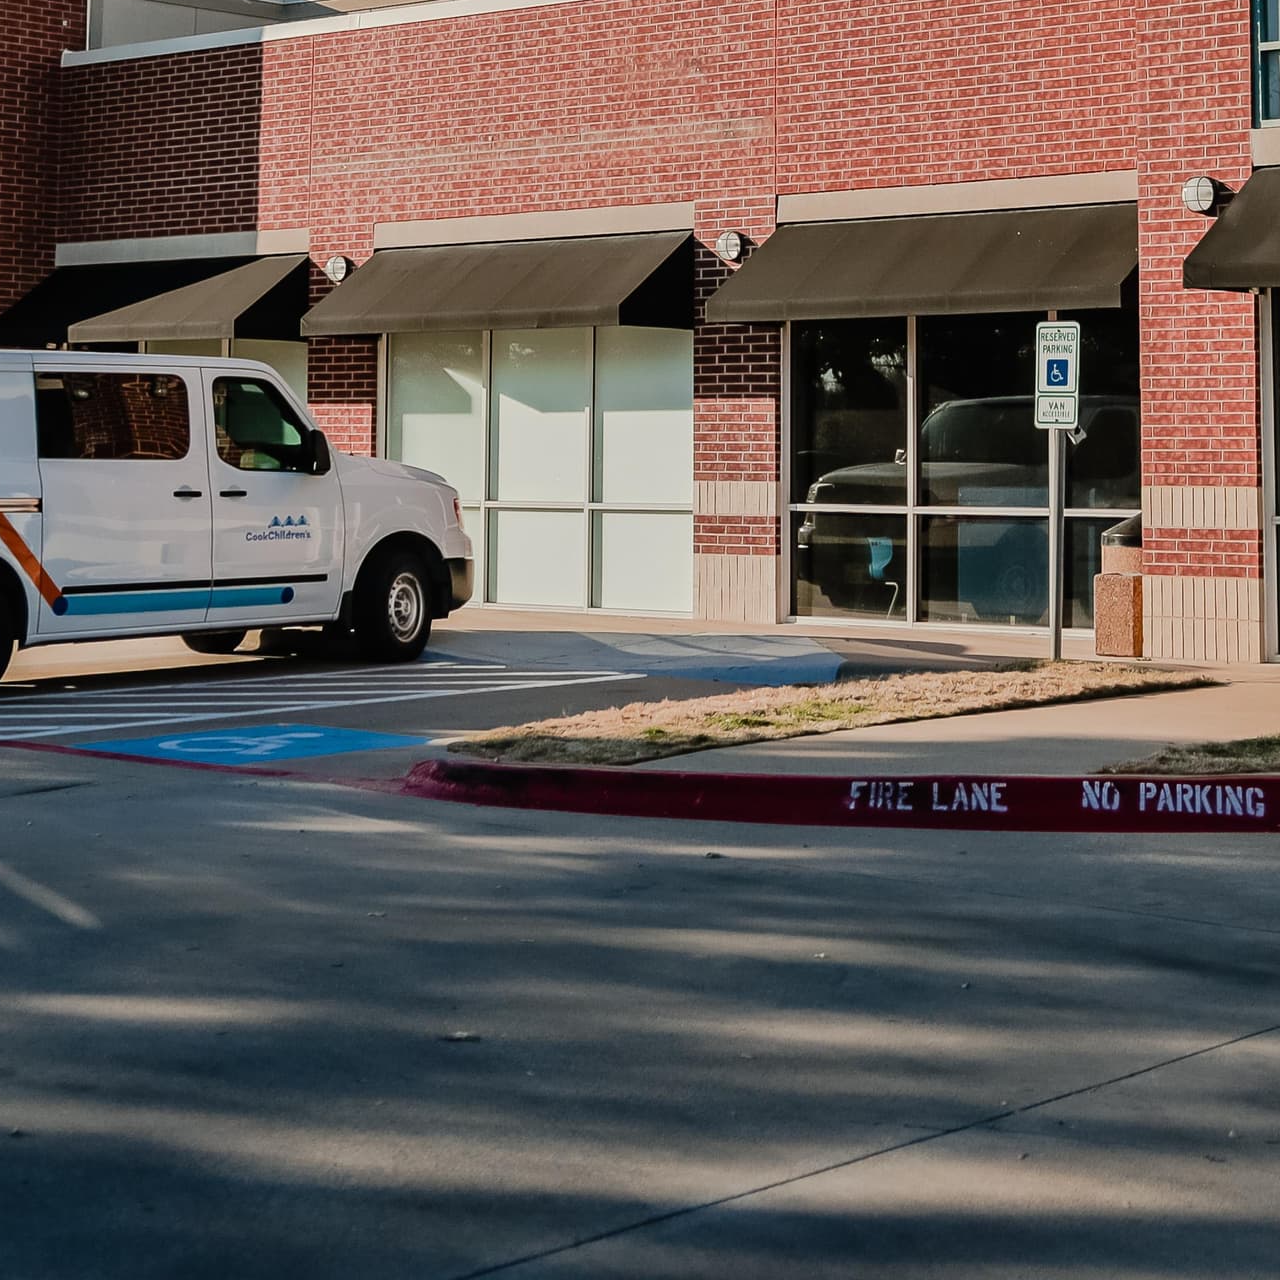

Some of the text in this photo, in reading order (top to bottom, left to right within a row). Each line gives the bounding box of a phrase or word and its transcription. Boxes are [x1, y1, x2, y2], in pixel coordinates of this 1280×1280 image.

[1041, 332, 1075, 342] RESERVED
[1042, 344, 1072, 354] PARKING
[1048, 401, 1065, 410] VAN
[246, 529, 311, 541] CookChildren's
[849, 780, 1266, 817] FIRE LANE NO PARKING
